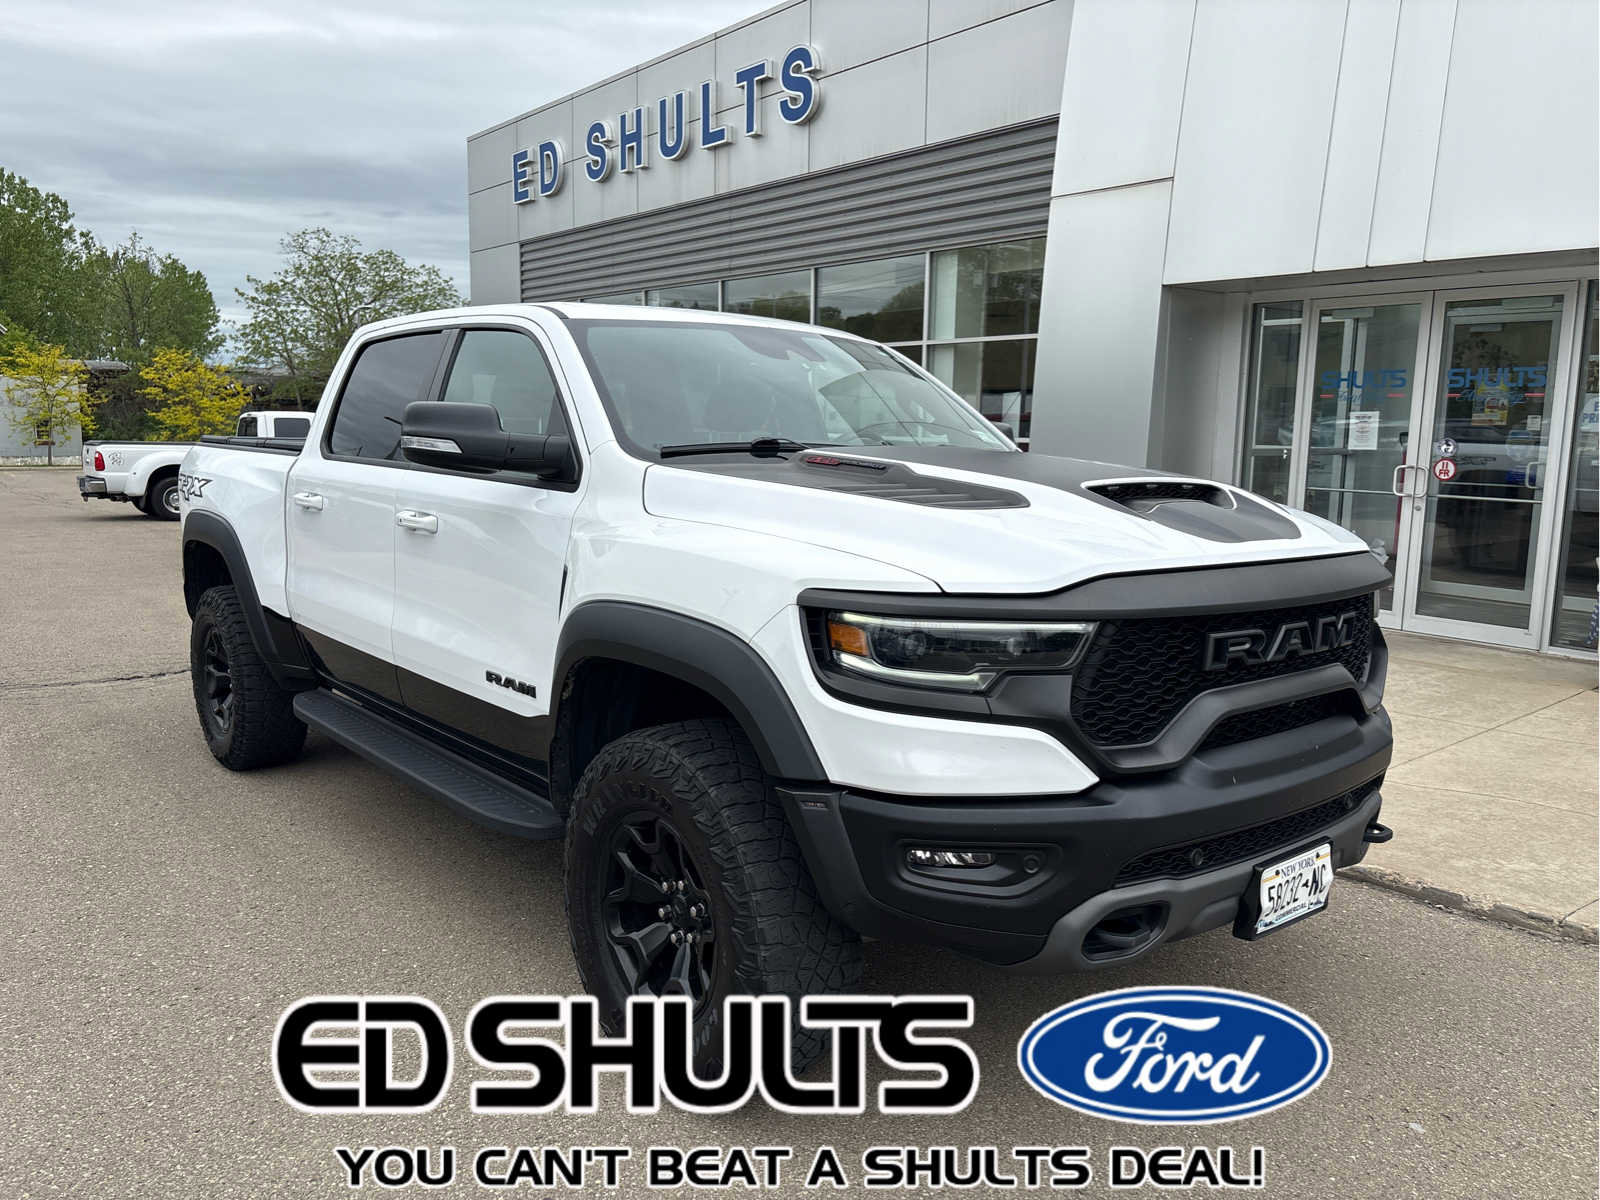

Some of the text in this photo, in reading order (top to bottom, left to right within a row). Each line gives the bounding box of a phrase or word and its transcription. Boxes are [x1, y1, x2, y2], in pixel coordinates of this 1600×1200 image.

[511, 43, 822, 204] ED SHULTS
[1321, 369, 1408, 390] SHULTS
[1447, 366, 1548, 389] SHULTS
[1206, 611, 1355, 670] RAM
[485, 670, 537, 699] RAM
[1281, 856, 1316, 878] NEW YORK
